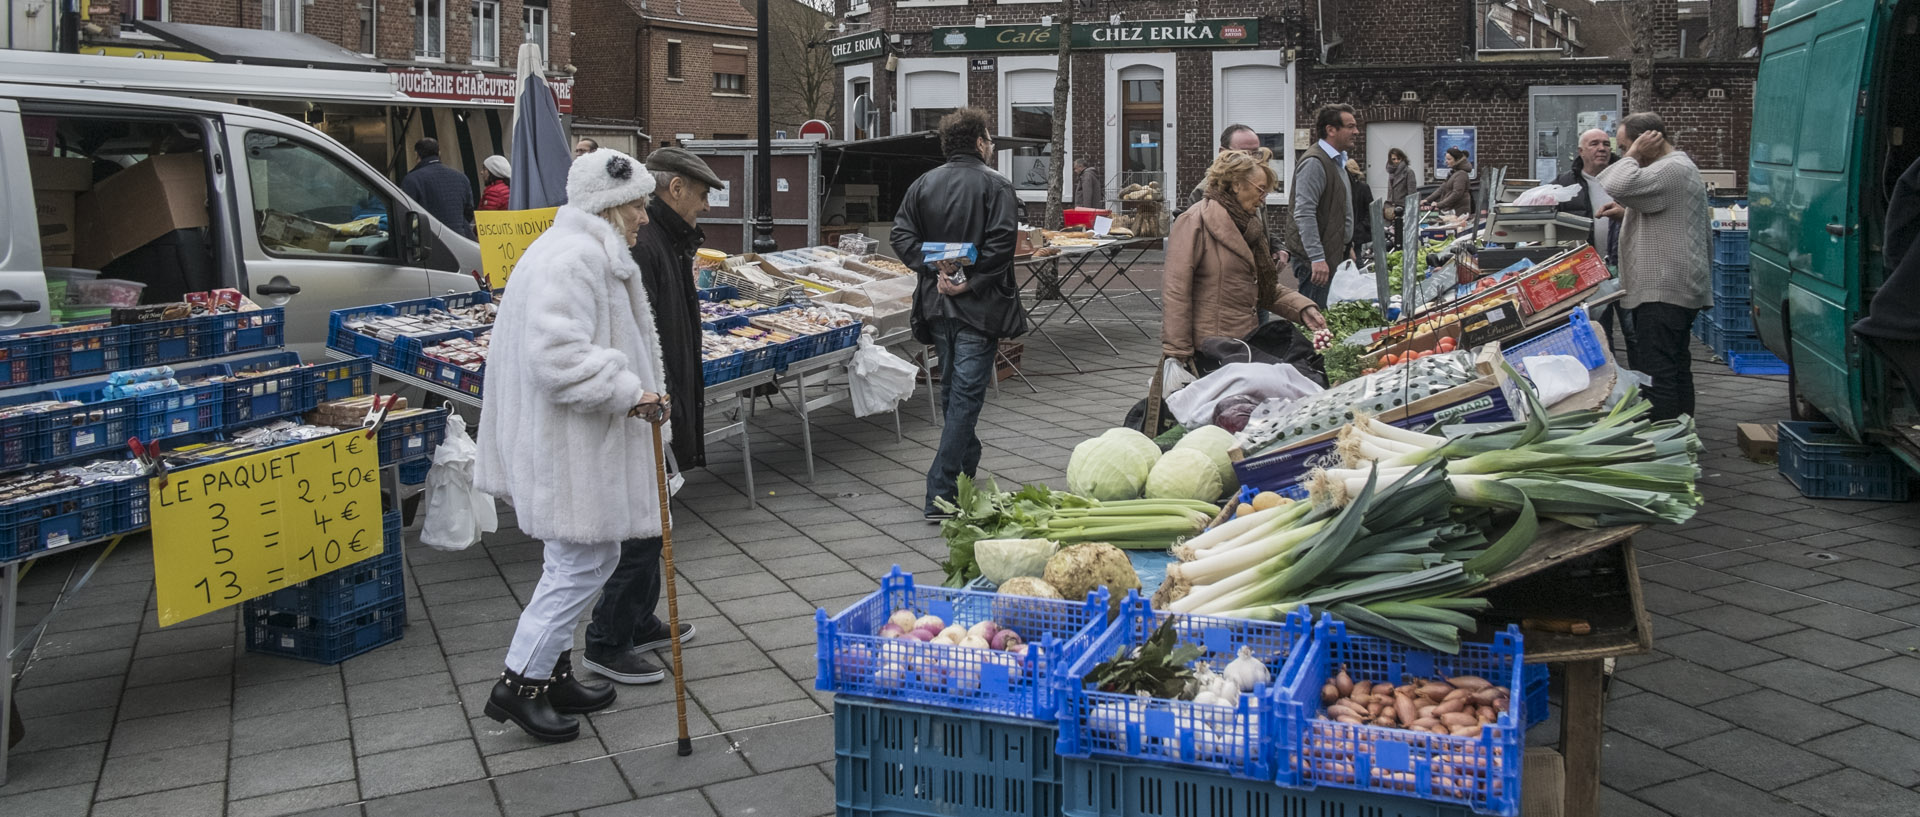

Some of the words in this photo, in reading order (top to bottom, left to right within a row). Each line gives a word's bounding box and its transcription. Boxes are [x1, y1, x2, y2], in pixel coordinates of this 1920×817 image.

[996, 27, 1051, 44] Café
[1092, 27, 1143, 42] CHEZ
[1150, 25, 1214, 40] ERIKA
[831, 42, 852, 57] CHEZ
[854, 36, 882, 53] ERIKA
[456, 76, 516, 96] CHARCUTER
[478, 223, 513, 236] BISCUITS
[498, 242, 515, 260] 10
[160, 480, 193, 507] LE
[202, 452, 301, 496] PAQUET
[208, 503, 230, 532] 3
[212, 535, 234, 565] 5
[194, 570, 243, 604] 13
